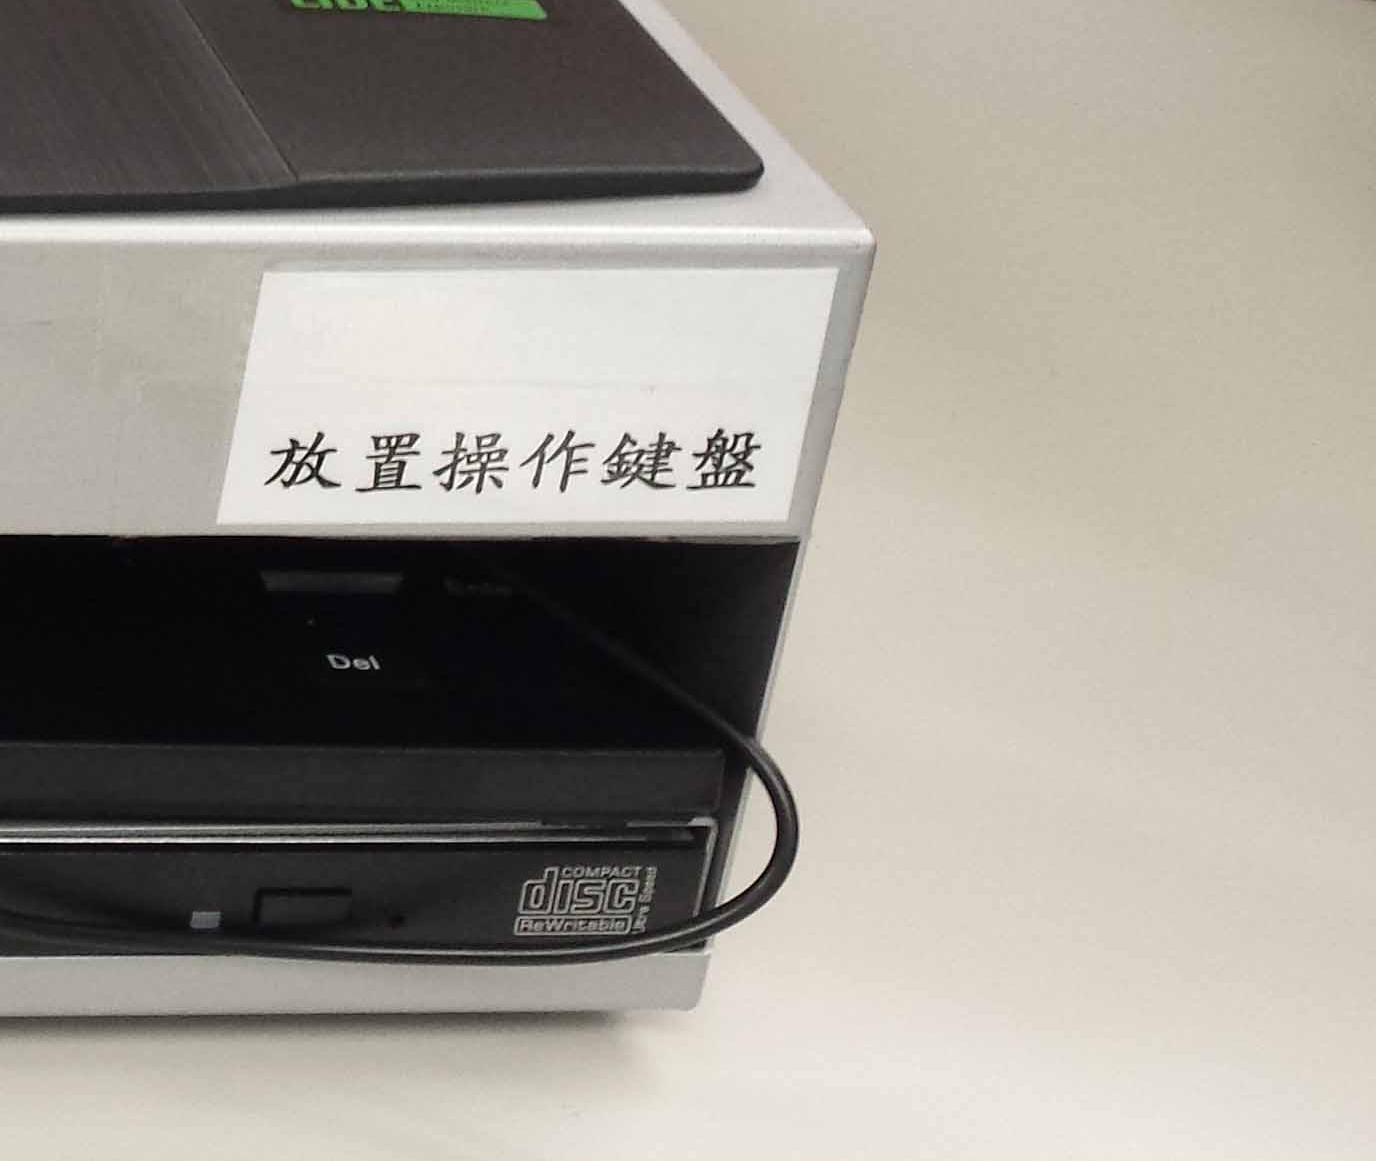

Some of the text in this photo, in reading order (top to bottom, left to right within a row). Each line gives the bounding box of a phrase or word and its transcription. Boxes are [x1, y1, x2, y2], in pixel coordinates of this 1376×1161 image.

[264, 427, 763, 495] 放置操作鍵盤
[327, 652, 380, 672] Del
[561, 866, 642, 878] COMPACT
[518, 866, 640, 915] disc
[520, 918, 626, 931] ReWritable
